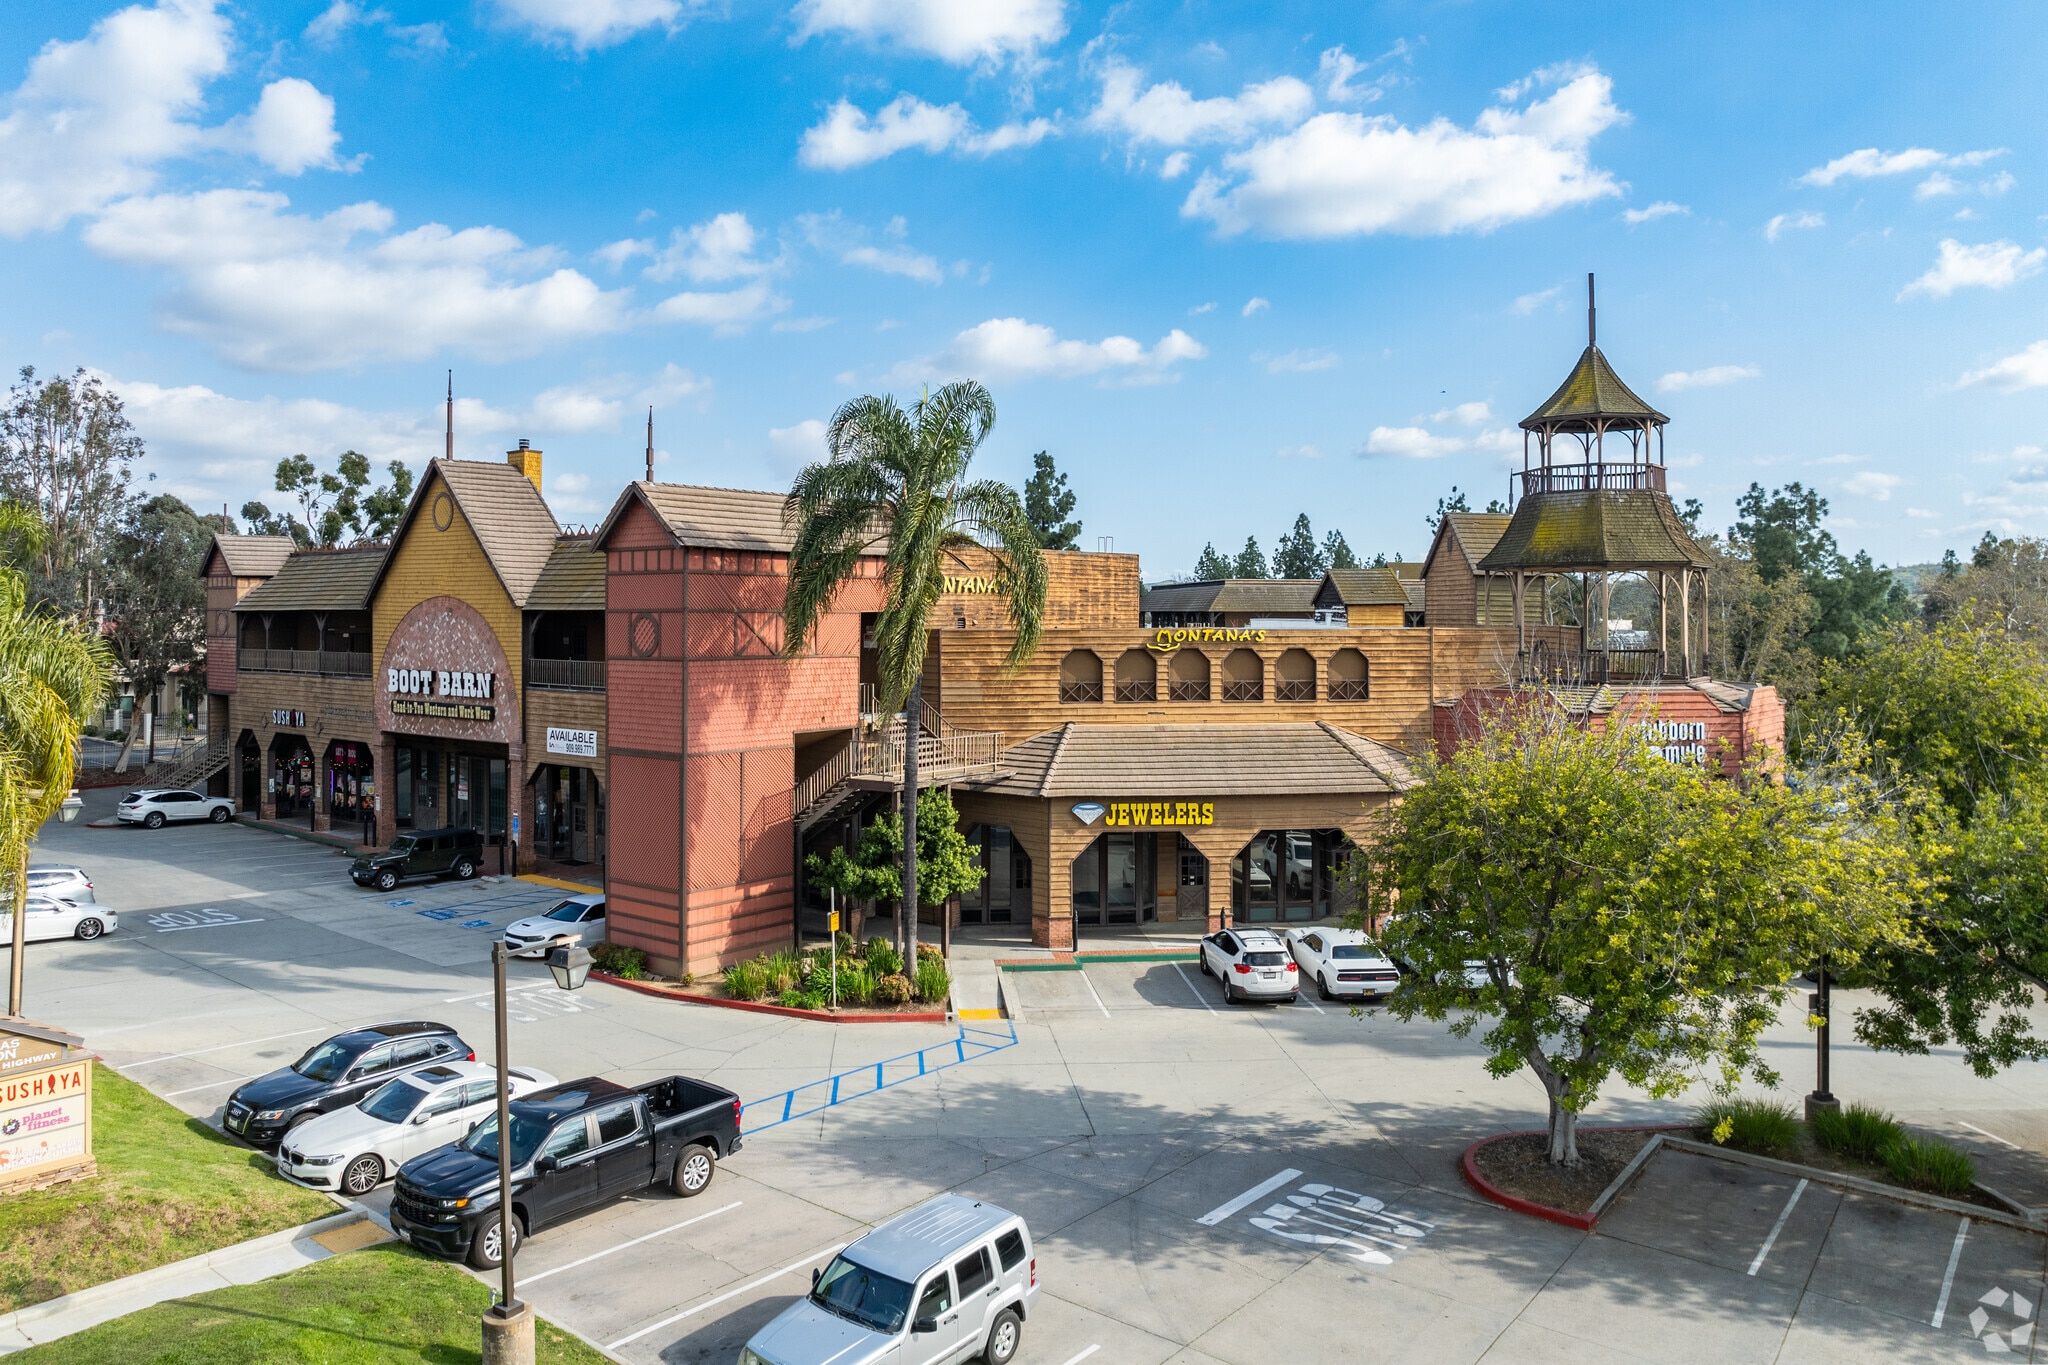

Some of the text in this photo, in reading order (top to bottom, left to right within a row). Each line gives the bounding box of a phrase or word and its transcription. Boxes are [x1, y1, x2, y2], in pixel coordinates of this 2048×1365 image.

[1155, 629, 1266, 646] MONTANA'S
[388, 668, 492, 699] BOOT BARN
[424, 702, 447, 717] Western
[448, 705, 458, 717] and
[459, 705, 474, 719] Work
[475, 706, 491, 720] Wear
[549, 730, 594, 744] AVAILABLE
[1105, 802, 1214, 826] JEWELERS
[148, 908, 240, 928] STOP
[2, 1052, 57, 1070] HIGHWAY
[22, 1106, 62, 1126] planet
[27, 1115, 70, 1131] fitness
[1249, 1184, 1435, 1265] STOP
